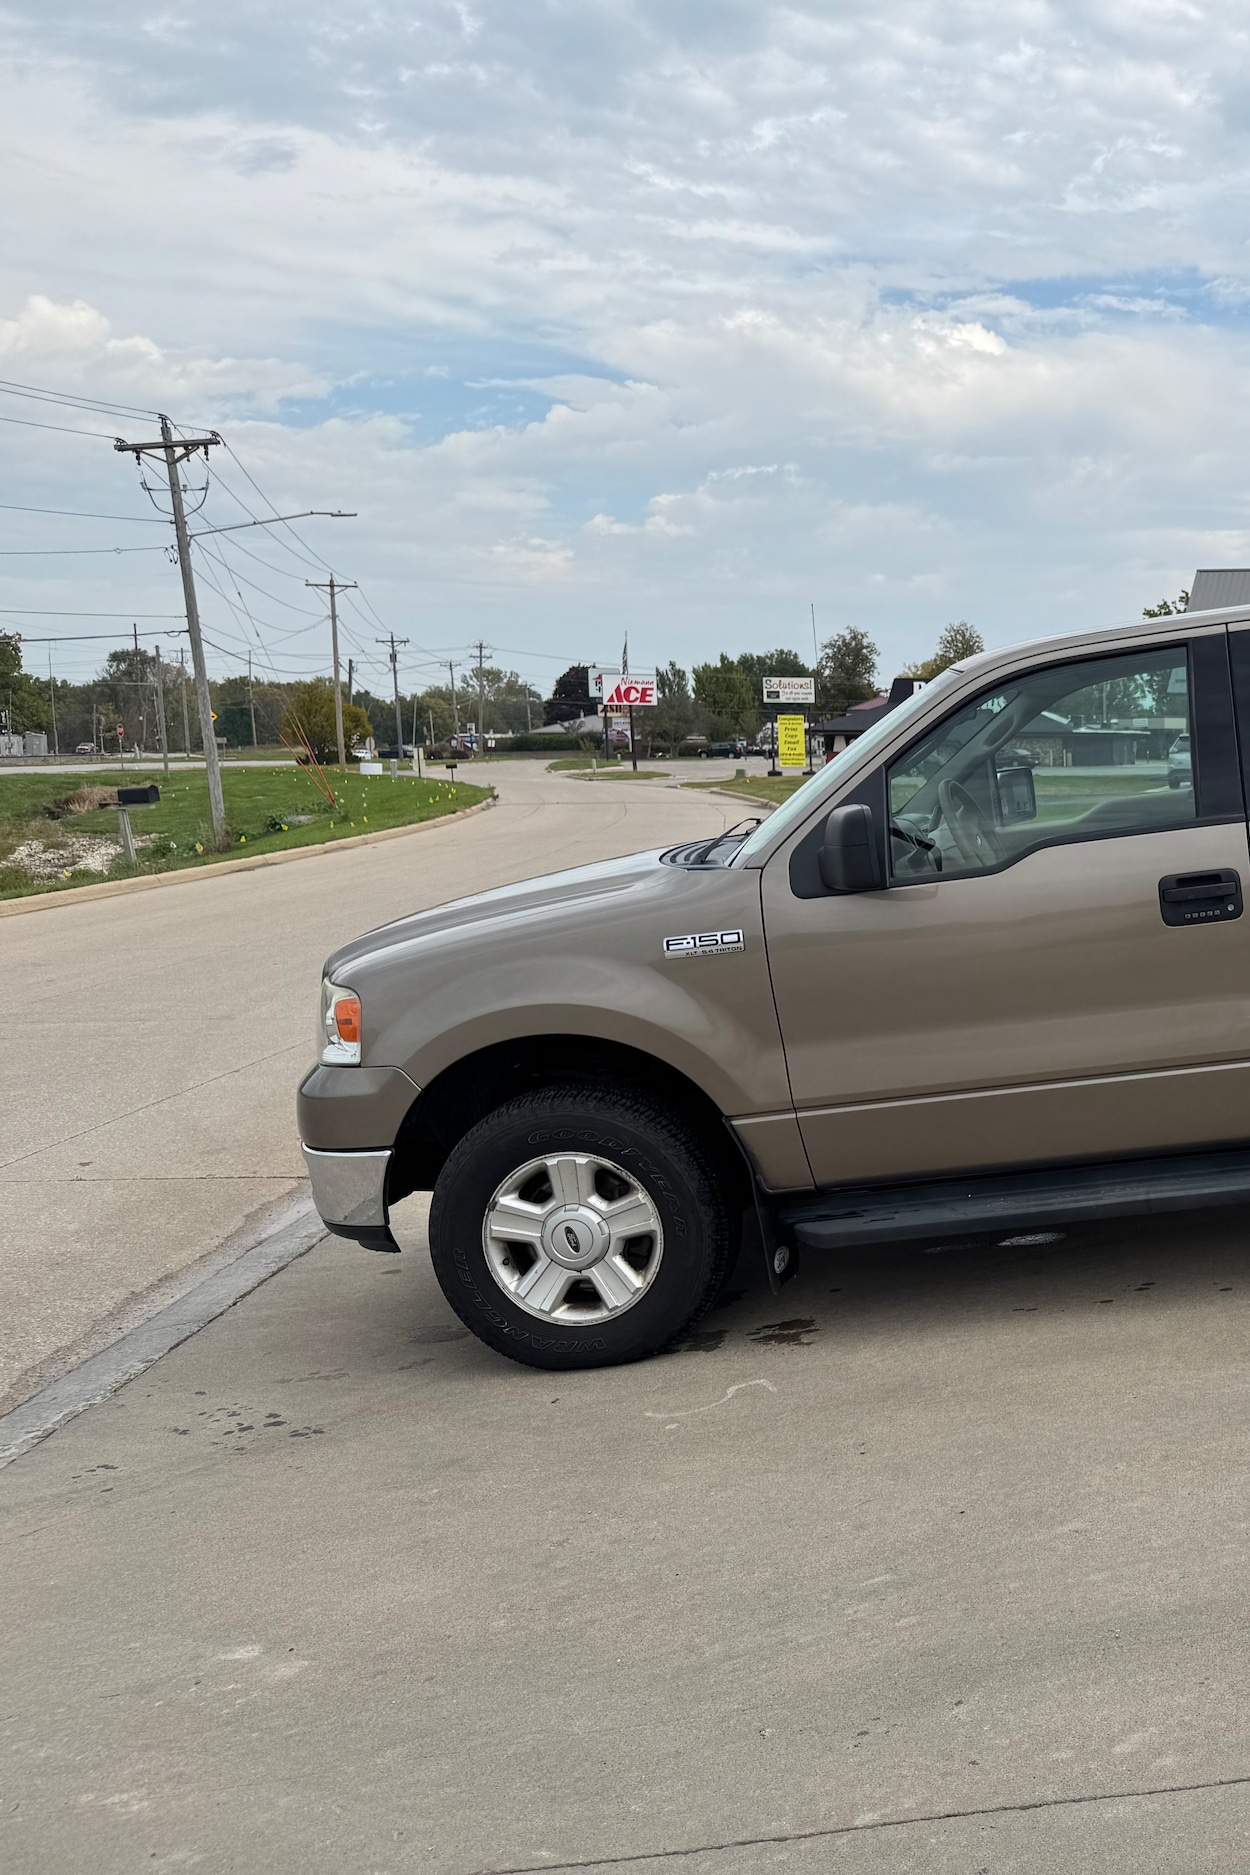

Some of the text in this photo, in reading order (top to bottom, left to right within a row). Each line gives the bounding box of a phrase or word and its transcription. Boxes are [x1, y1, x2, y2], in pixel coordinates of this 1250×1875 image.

[607, 683, 654, 703] ACE
[764, 678, 812, 690] Solutions!
[665, 931, 741, 952] F-150
[527, 1128, 687, 1239] GOODYEAR
[454, 1248, 607, 1353] WRANGLER
